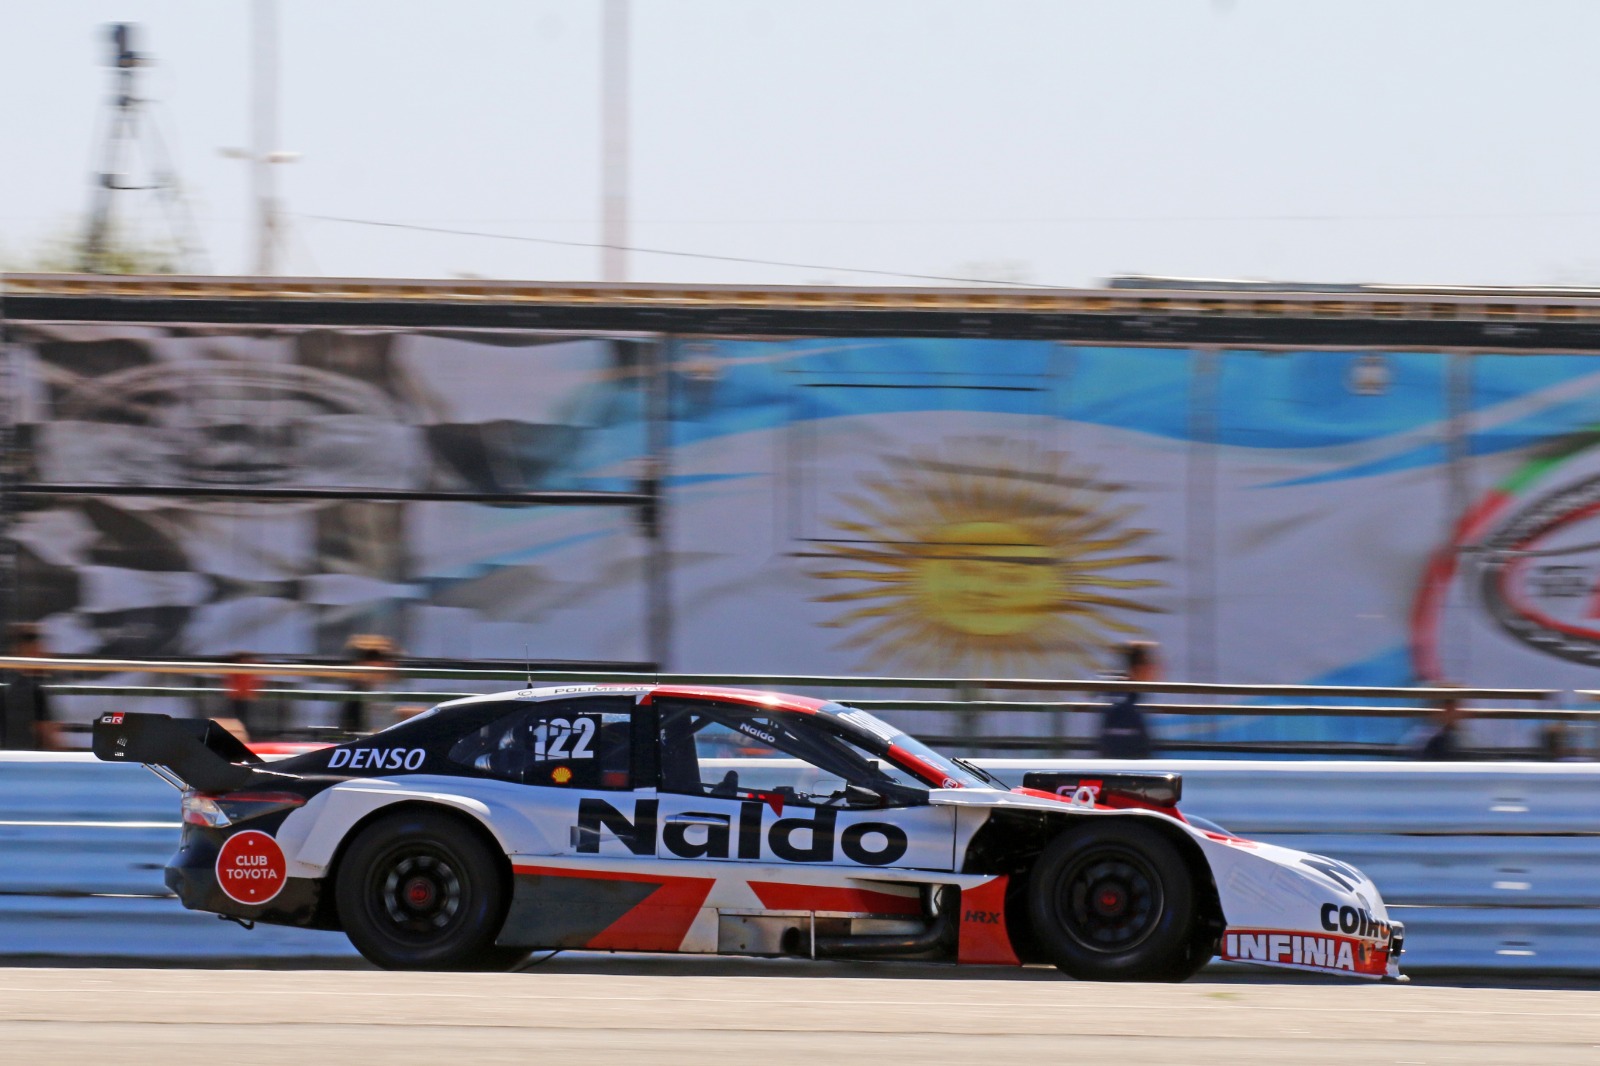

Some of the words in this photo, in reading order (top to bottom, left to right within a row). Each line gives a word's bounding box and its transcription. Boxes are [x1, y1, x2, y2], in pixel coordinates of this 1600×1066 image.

[102, 716, 124, 724] GR
[532, 717, 596, 762] 122
[740, 722, 776, 743] Naldo
[327, 748, 426, 771] DENSO
[576, 798, 908, 866] Naldo
[235, 855, 268, 866] CLUB
[226, 868, 278, 879] TOYOTA
[965, 910, 1001, 924] HRX
[1227, 934, 1355, 972] INFINIA
